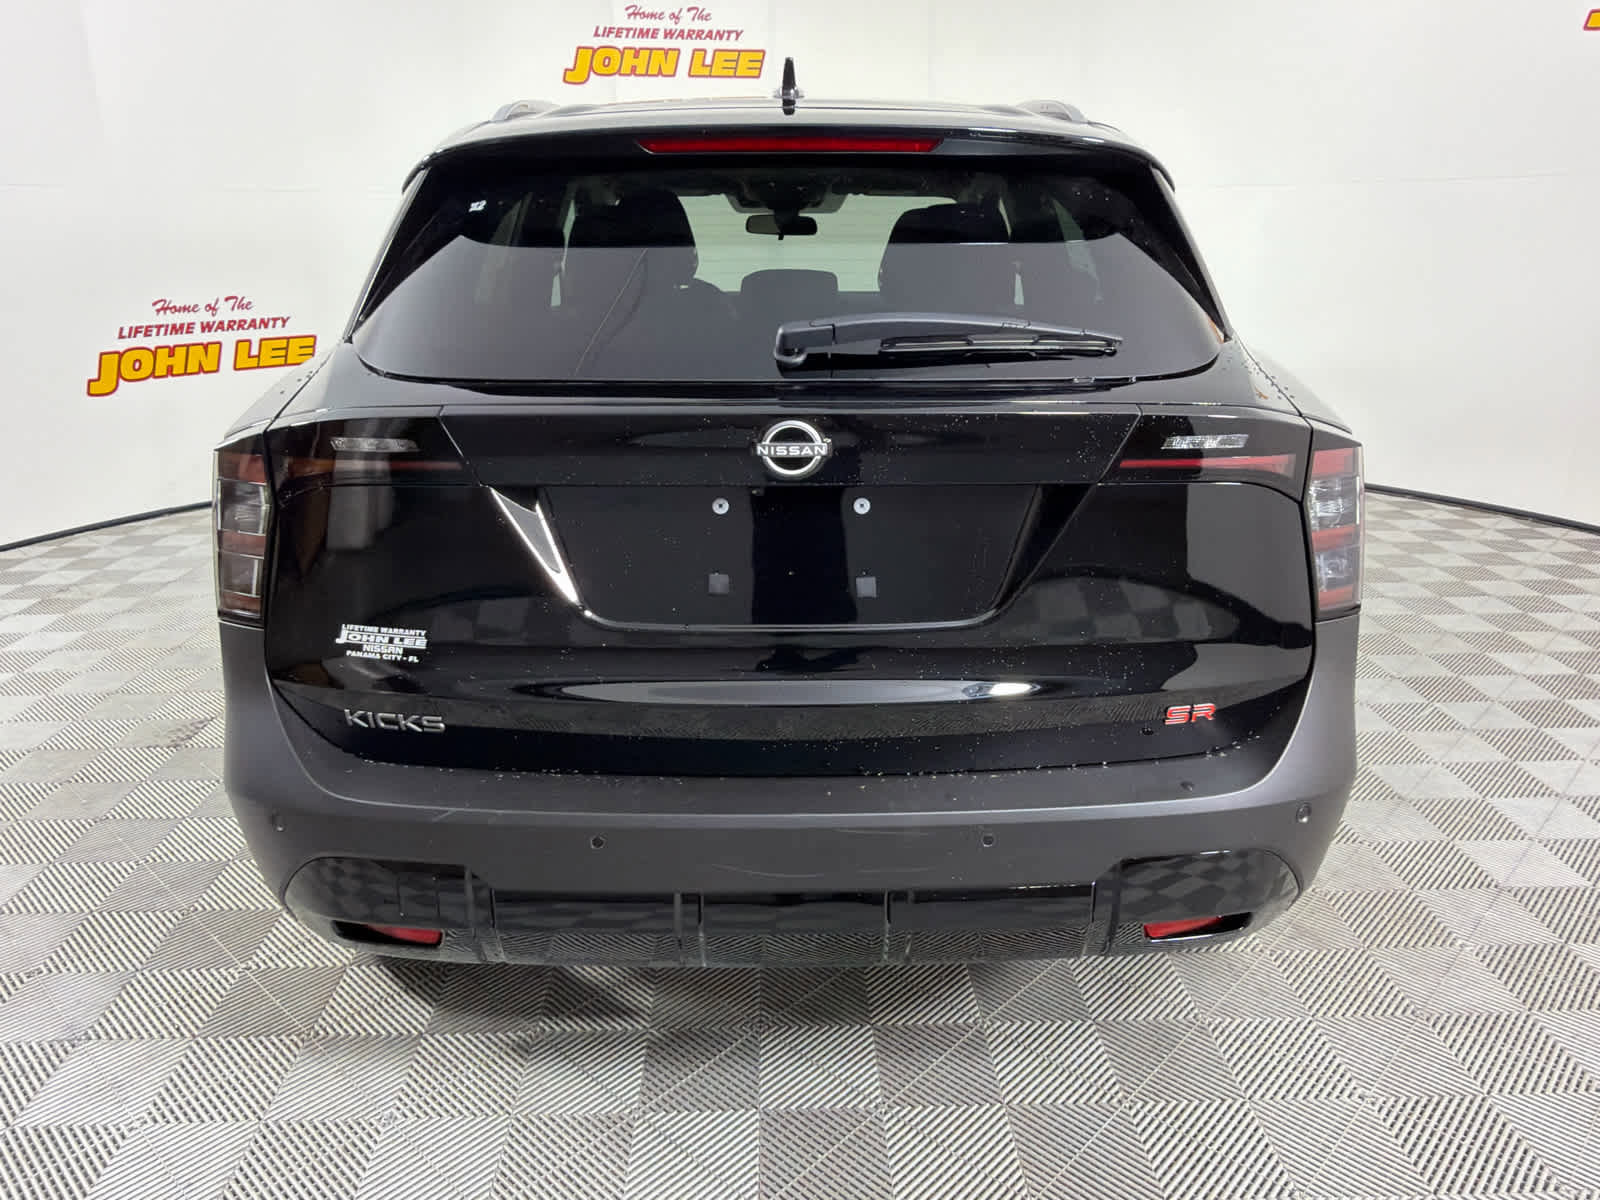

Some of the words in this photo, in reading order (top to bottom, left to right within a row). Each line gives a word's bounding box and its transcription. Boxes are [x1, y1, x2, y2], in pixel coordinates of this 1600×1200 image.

[624, 4, 665, 21] Home
[668, 7, 684, 25] of
[686, 6, 713, 22] The
[593, 26, 660, 39] LIFETIME
[663, 28, 744, 41] WARRANTY
[563, 45, 680, 85] JOHN
[688, 48, 766, 79] LEE
[152, 298, 201, 317] Home
[204, 297, 220, 317] of
[224, 295, 254, 312] The
[117, 321, 196, 340] LIFETIME
[200, 316, 291, 334] WARRANTY
[87, 341, 222, 397] JOHN
[233, 334, 317, 371] LEE
[756, 445, 827, 457] NISSAN
[335, 629, 389, 644] JOHN
[393, 636, 428, 649] LEE
[341, 623, 379, 633] LIFETIME
[380, 627, 427, 636] WARRANTY
[346, 650, 381, 659] PANAMA
[382, 653, 402, 661] CITY
[408, 655, 420, 663] FL
[362, 645, 404, 654] NISSAN
[344, 708, 446, 733] KICKS
[1165, 703, 1216, 725] SR
